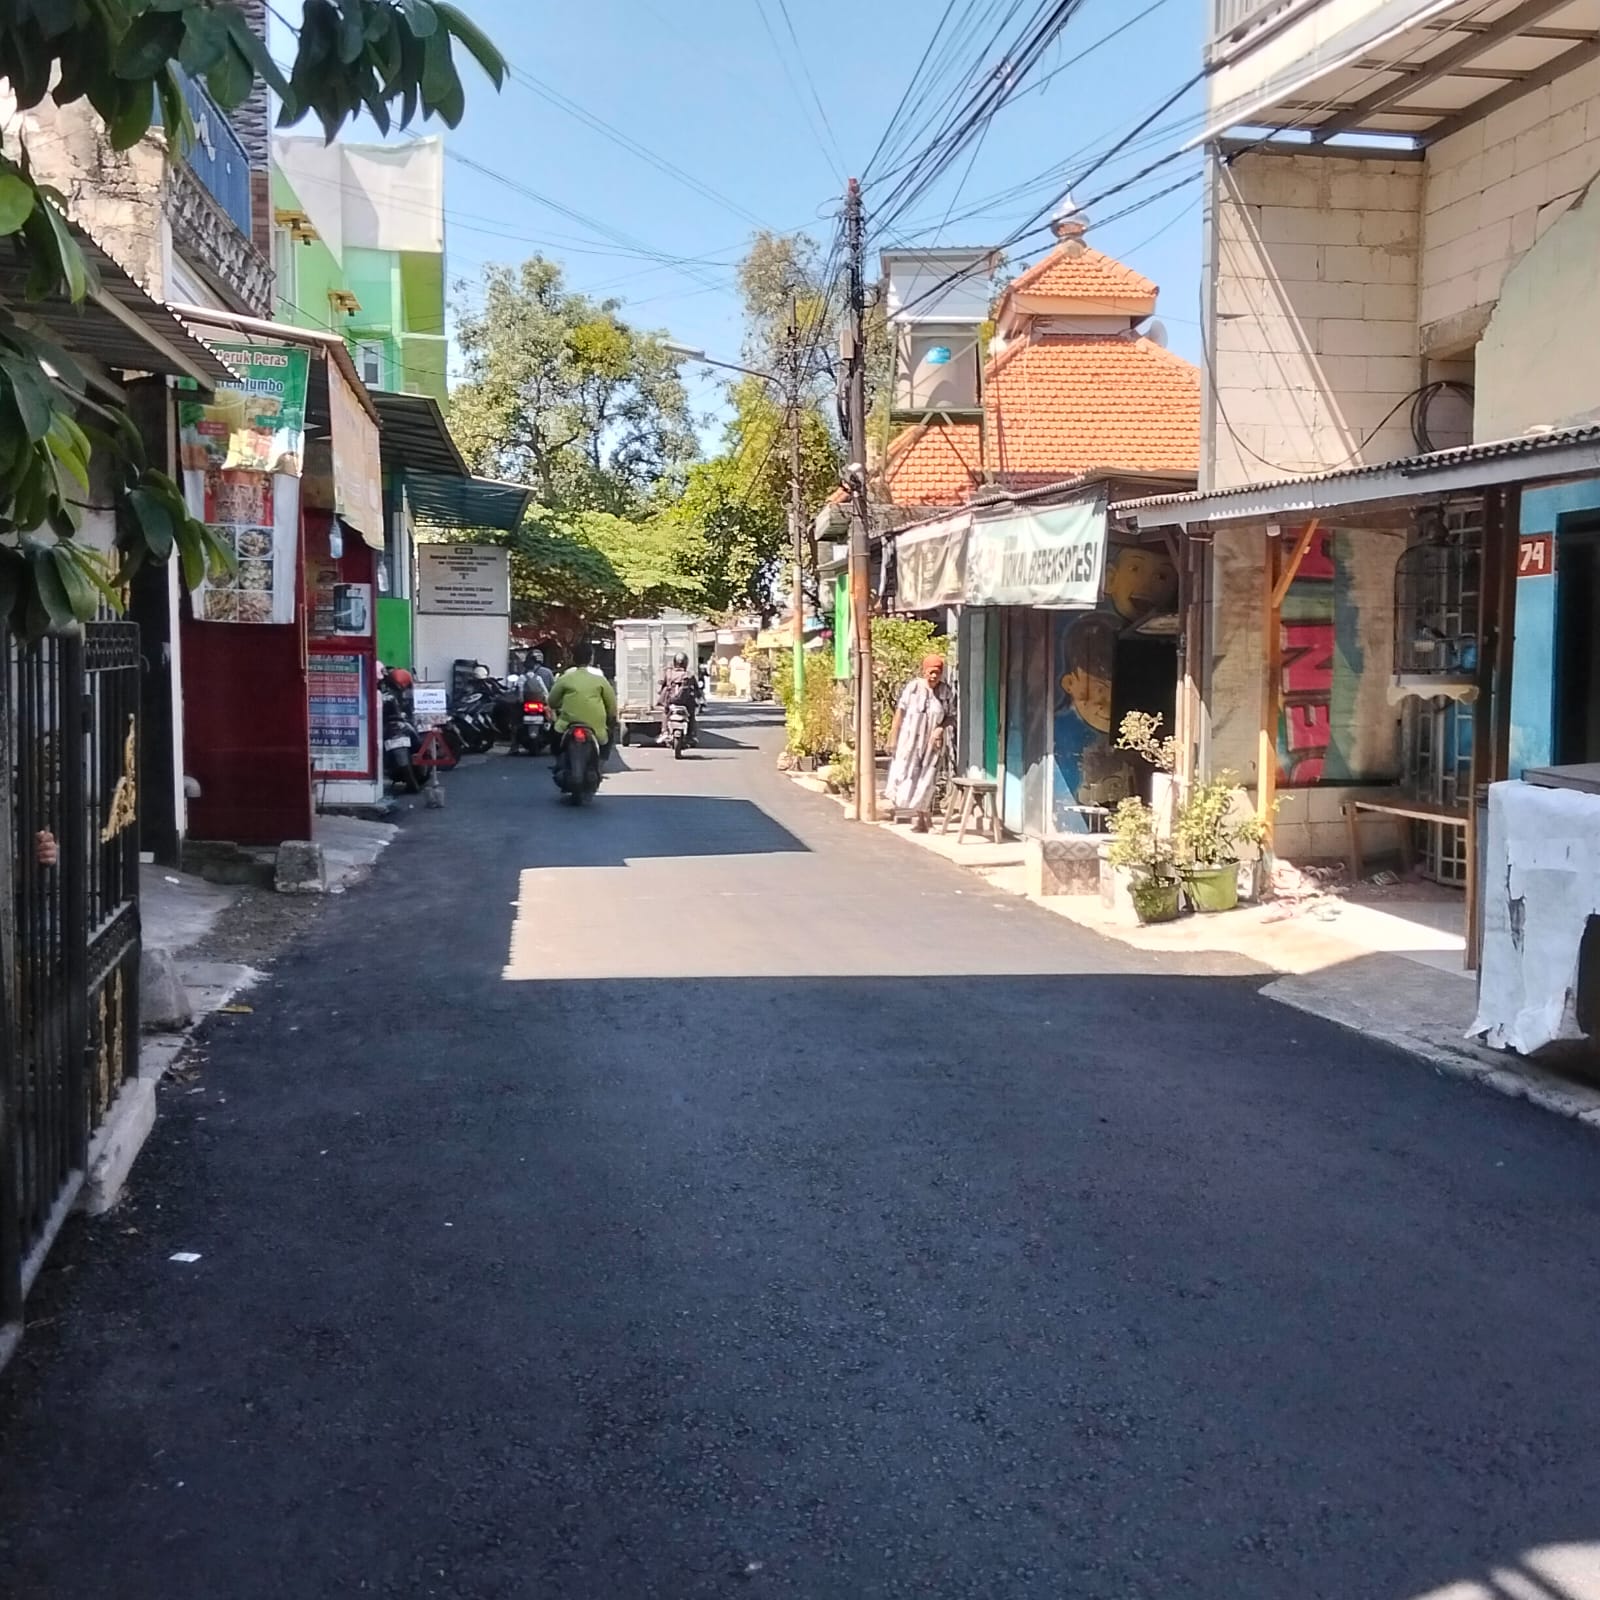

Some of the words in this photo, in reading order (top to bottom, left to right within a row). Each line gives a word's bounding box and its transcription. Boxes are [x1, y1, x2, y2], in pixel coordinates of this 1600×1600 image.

[253, 351, 289, 367] Peras
[245, 378, 284, 392] Jumbo
[1520, 541, 1545, 571] 74
